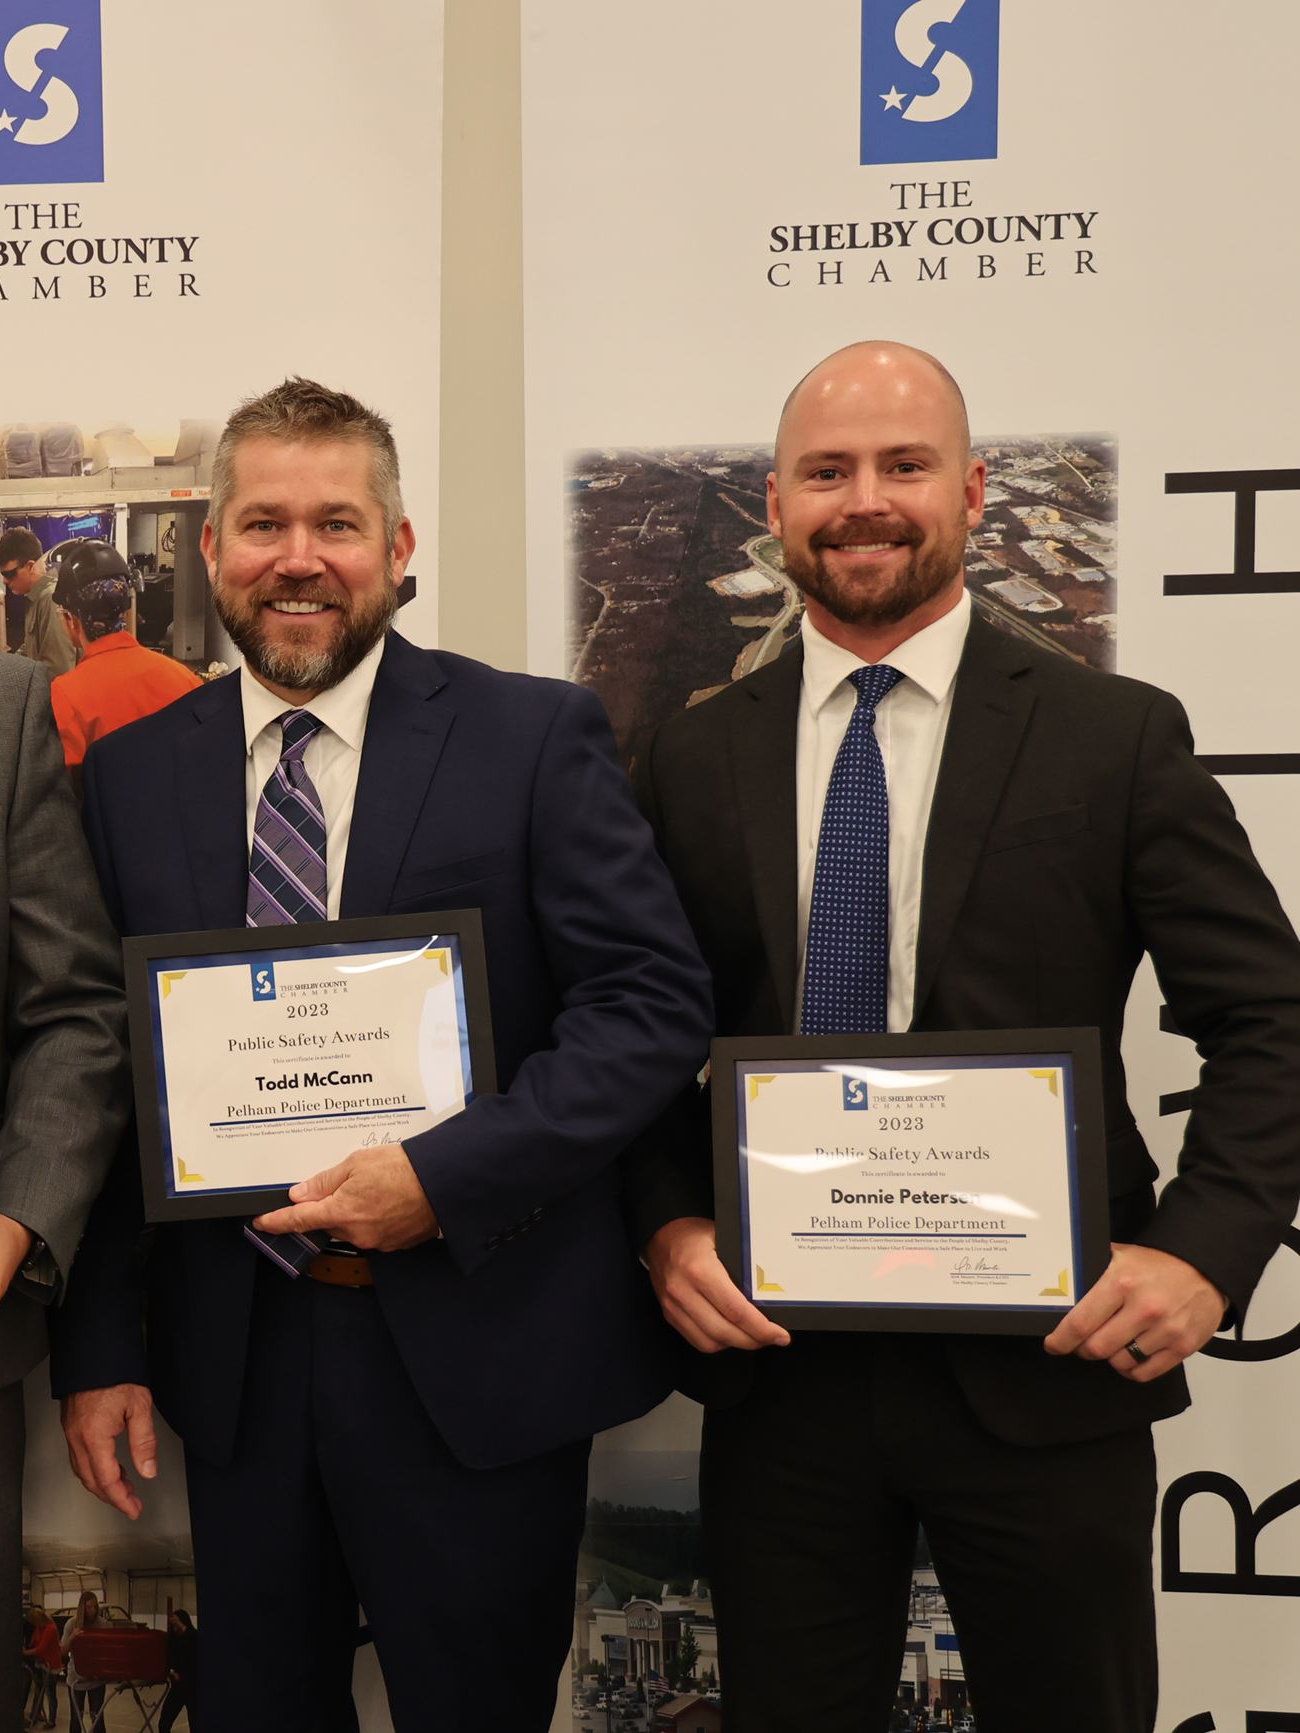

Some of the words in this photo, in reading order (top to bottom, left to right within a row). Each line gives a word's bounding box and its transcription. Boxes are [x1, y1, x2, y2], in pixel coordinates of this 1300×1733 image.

[889, 179, 973, 210] THE
[3, 202, 83, 230] THE
[768, 219, 919, 253] SHELBY
[926, 211, 1099, 246] COUNTY
[39, 235, 200, 266] COUNTY
[766, 249, 1098, 288] CHAMBER
[280, 988, 348, 998] CHAMBER
[319, 980, 348, 988] COUNTY
[286, 1002, 329, 1019] 2023
[227, 1036, 274, 1052] Public
[278, 1032, 327, 1049] Safety
[331, 1026, 390, 1044] Awards
[254, 1073, 299, 1091] Todd
[303, 1071, 373, 1088] McCann
[227, 1103, 276, 1118] Pelham
[280, 1099, 321, 1113] Police
[324, 1094, 407, 1111] Department
[878, 1116, 924, 1131] 2023
[868, 1146, 921, 1164] Safety
[925, 1145, 990, 1160] Awards
[830, 1188, 895, 1204] Donnie
[810, 1215, 863, 1229] Pelham
[867, 1216, 911, 1229] Police
[914, 1216, 1005, 1233] Department
